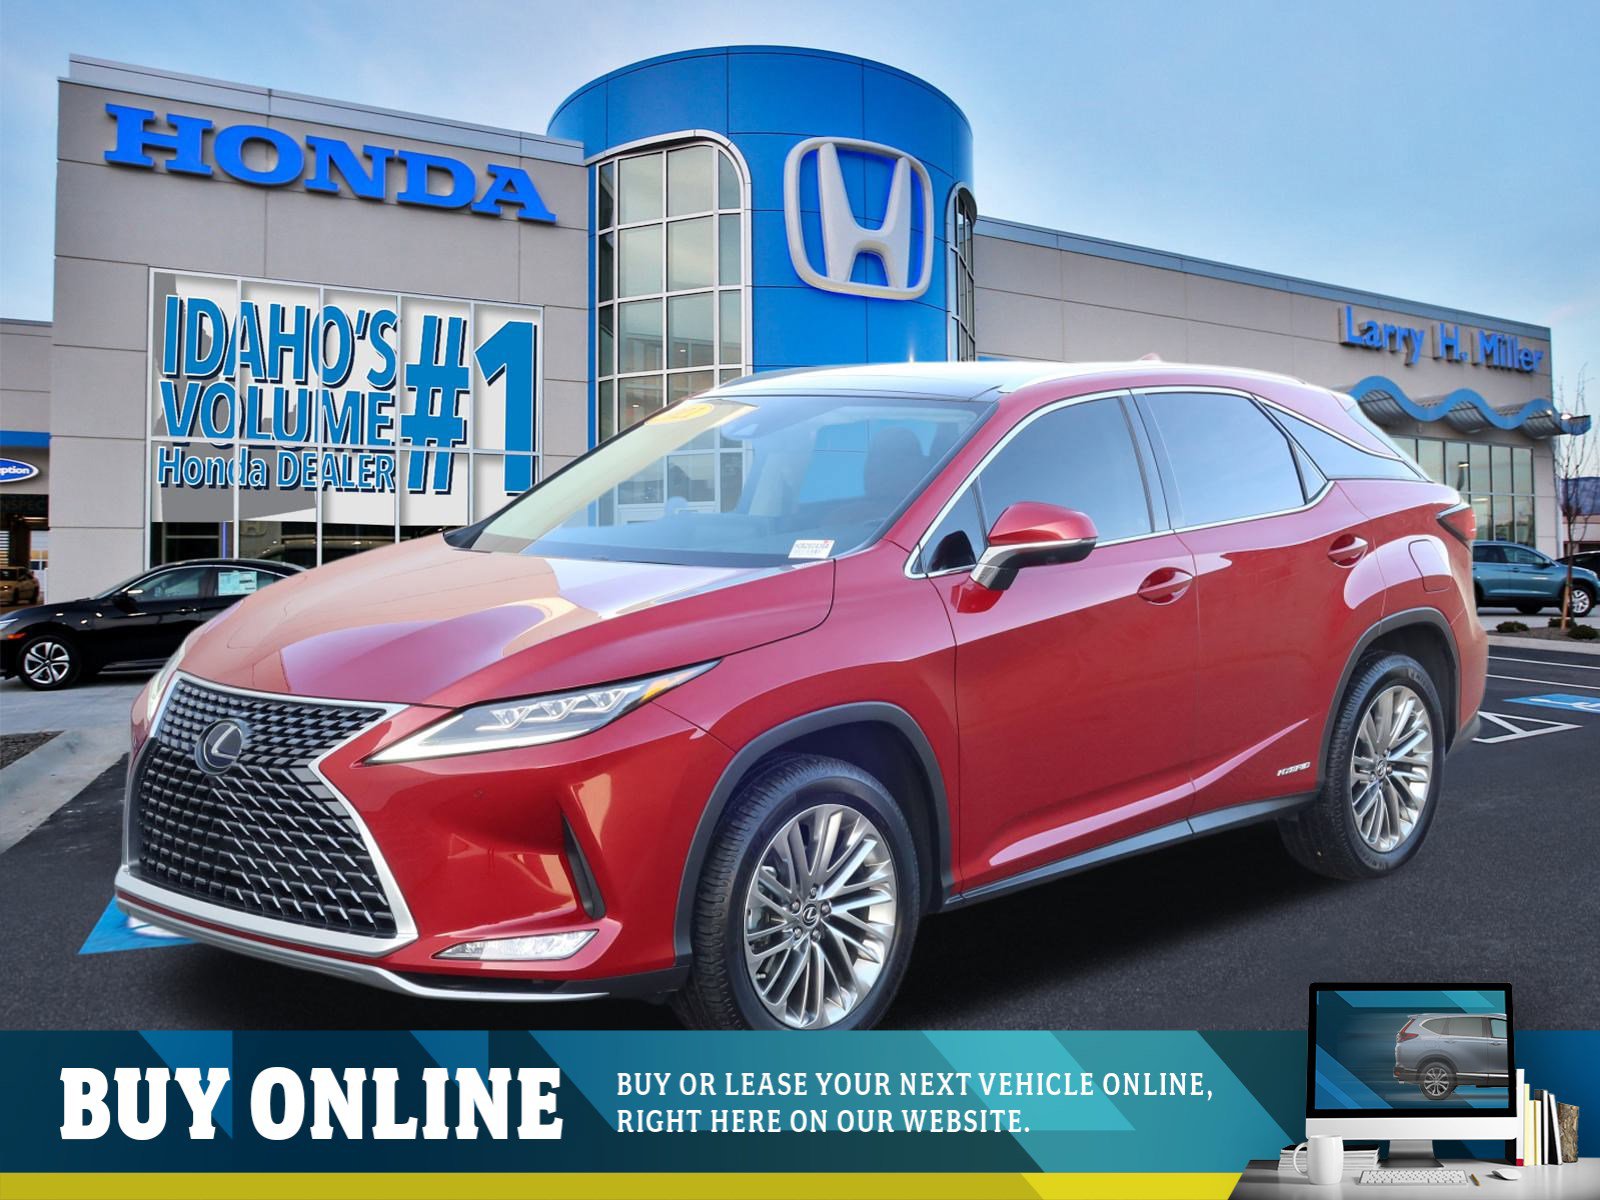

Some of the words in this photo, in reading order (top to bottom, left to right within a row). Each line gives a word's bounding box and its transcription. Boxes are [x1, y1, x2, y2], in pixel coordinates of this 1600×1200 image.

[104, 102, 558, 225] HONDA
[162, 294, 399, 391] IDAHO'S
[1344, 304, 1426, 367] Larry
[1439, 322, 1469, 363] H.
[1478, 329, 1545, 373] Miller
[159, 380, 397, 453] VOLUME
[0, 465, 30, 476] ption
[156, 446, 270, 490] Honda
[275, 450, 396, 494] DEALER
